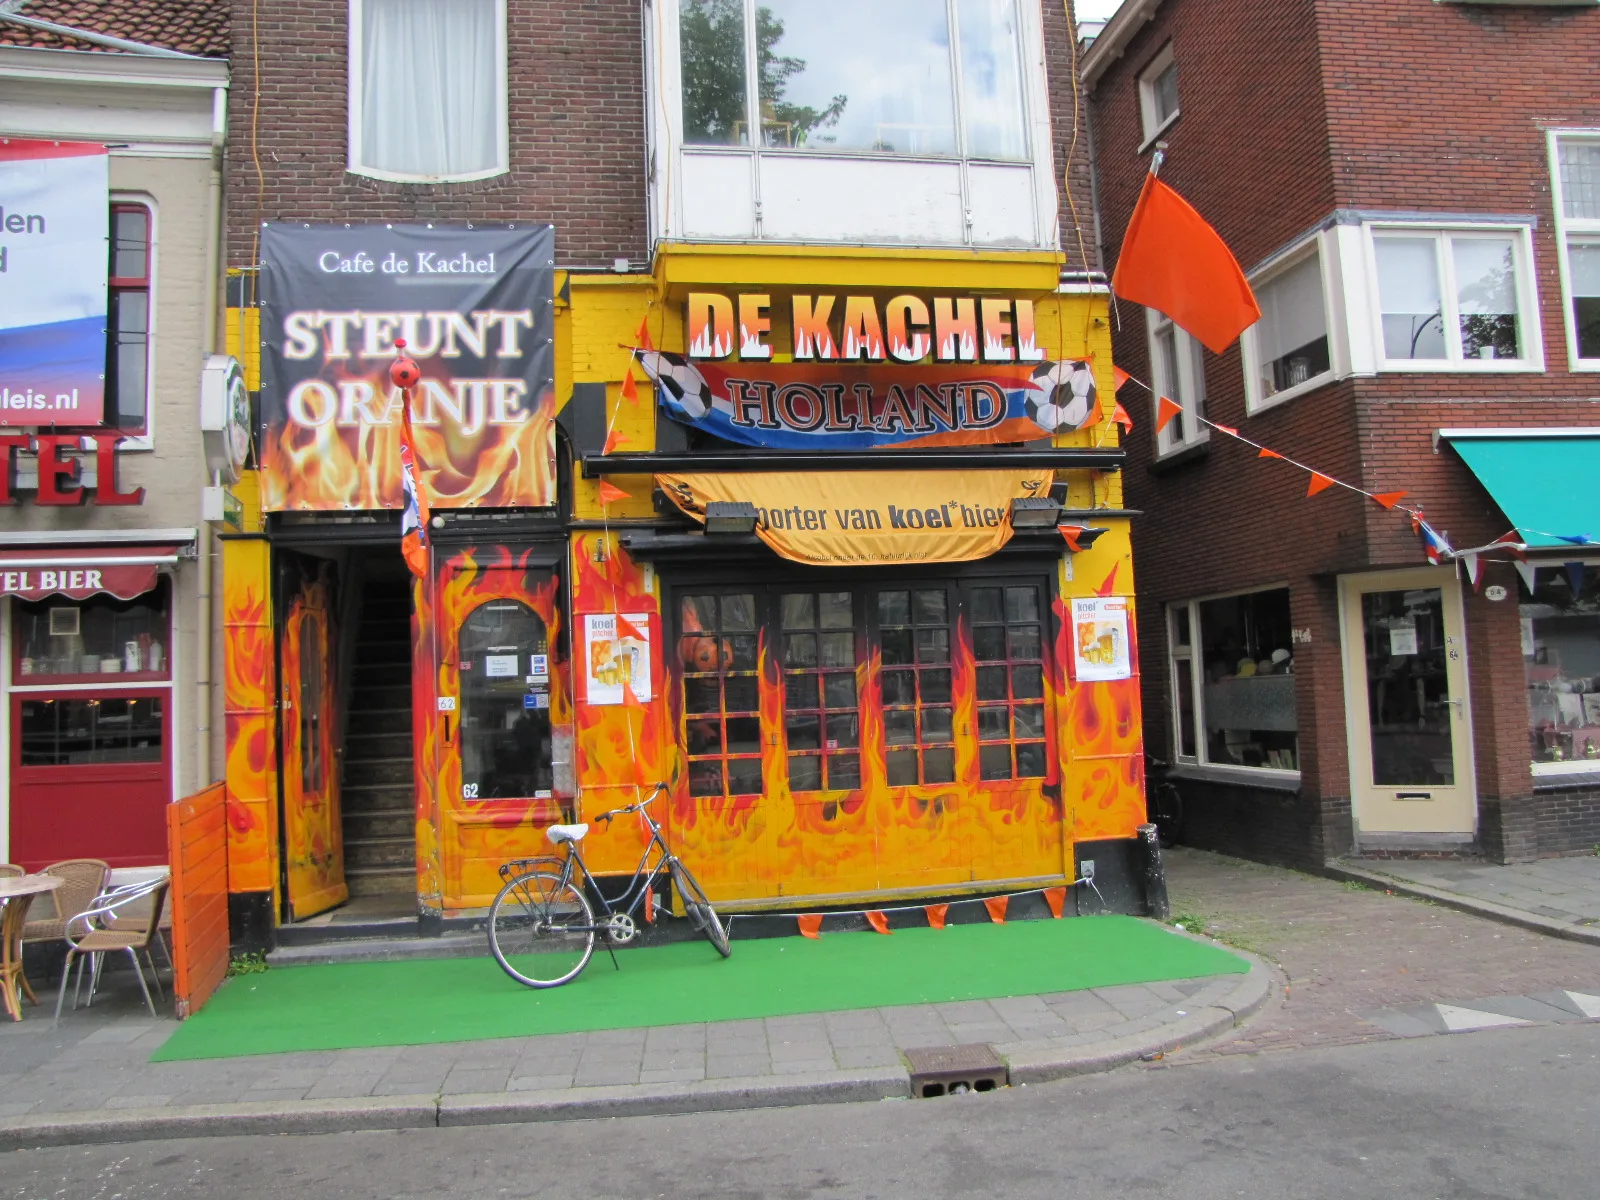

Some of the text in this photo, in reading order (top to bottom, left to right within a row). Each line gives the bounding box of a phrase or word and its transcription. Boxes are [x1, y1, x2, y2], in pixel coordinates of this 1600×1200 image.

[319, 252, 496, 273] Cafe de Kachel
[283, 310, 534, 360] STEUNT
[688, 293, 1048, 362] DE KACHEL
[0, 387, 78, 410] leis.nl
[287, 378, 530, 437] ORANJE
[724, 379, 1010, 434] HOLLAND
[834, 506, 882, 530] van
[0, 570, 104, 592] EL BIER
[440, 698, 454, 709] 62
[463, 783, 479, 799] 62
